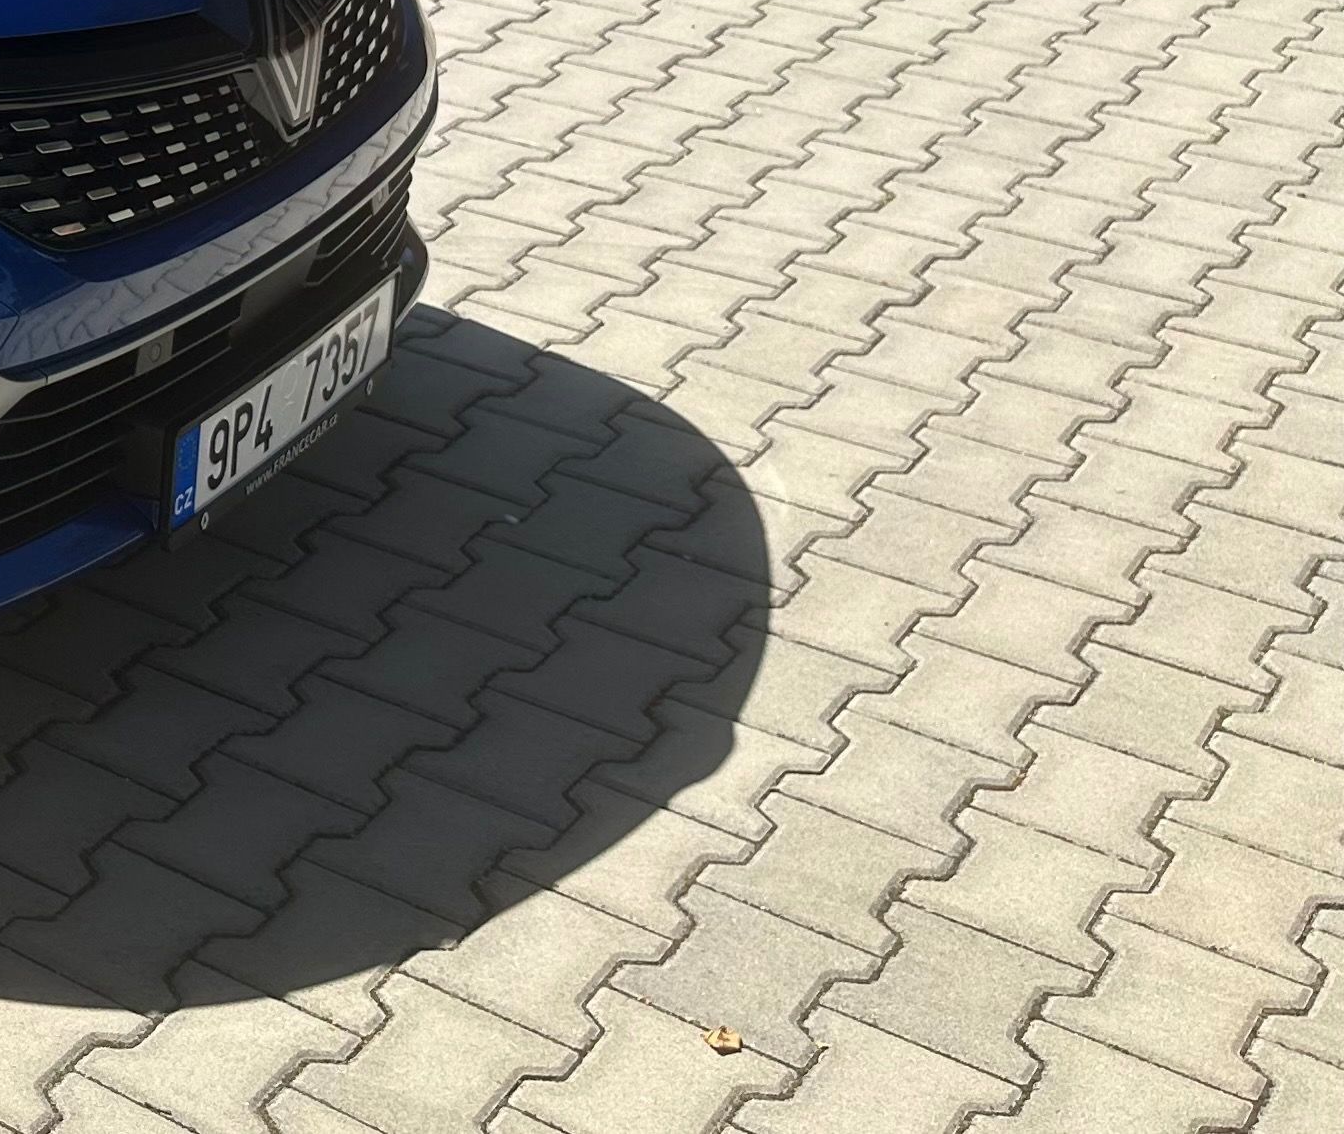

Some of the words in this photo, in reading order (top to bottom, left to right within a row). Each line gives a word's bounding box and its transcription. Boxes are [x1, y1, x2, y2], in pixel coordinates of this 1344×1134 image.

[207, 385, 274, 491] 9P4
[300, 297, 381, 423] 7357
[174, 486, 193, 517] CZ
